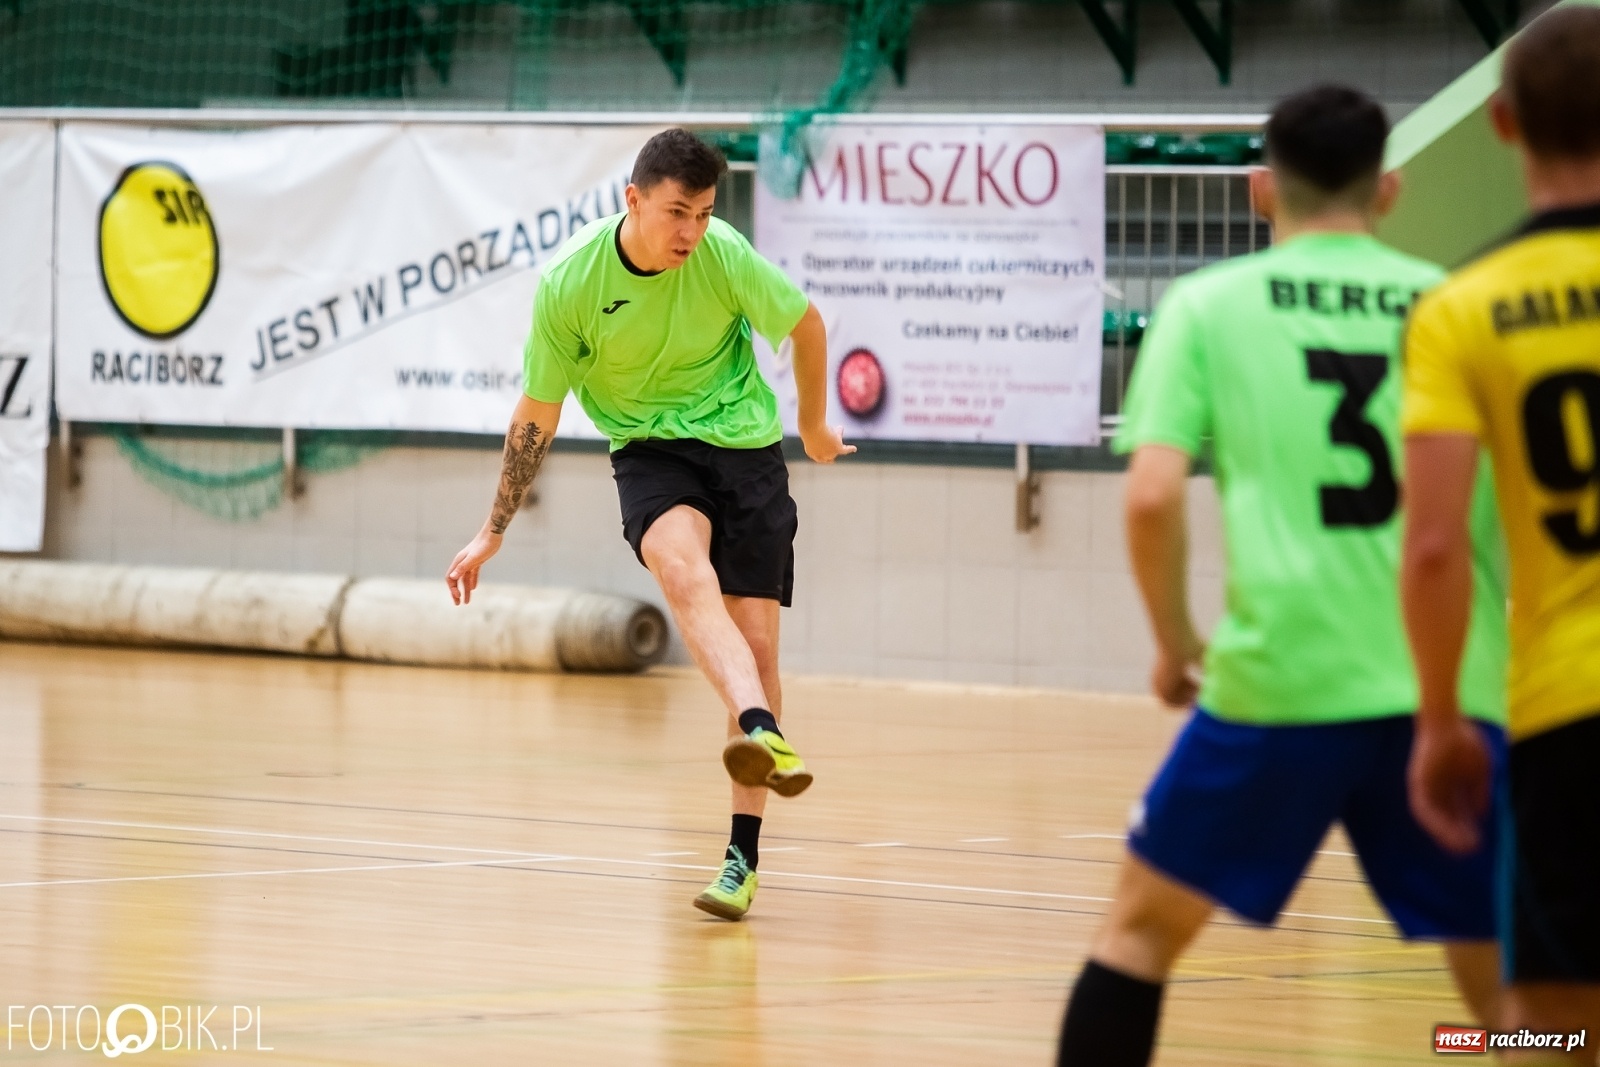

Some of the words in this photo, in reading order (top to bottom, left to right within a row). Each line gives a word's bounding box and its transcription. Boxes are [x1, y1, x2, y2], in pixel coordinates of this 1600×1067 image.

[796, 140, 1061, 208] MIESZKO
[250, 296, 340, 371] JEST
[353, 275, 385, 325] W
[397, 174, 631, 306] PORZĄDKU
[802, 253, 876, 277] Operator
[968, 256, 1096, 280] cukierniczych
[803, 281, 889, 298] Pracownik
[894, 284, 1006, 305] produkcyjny
[1270, 277, 1421, 318] BERG
[902, 320, 981, 344] Czekamy
[987, 325, 1009, 340] na
[1014, 321, 1079, 342] Ciebie!
[1303, 348, 1401, 527] 3
[1522, 366, 1600, 562] 9
